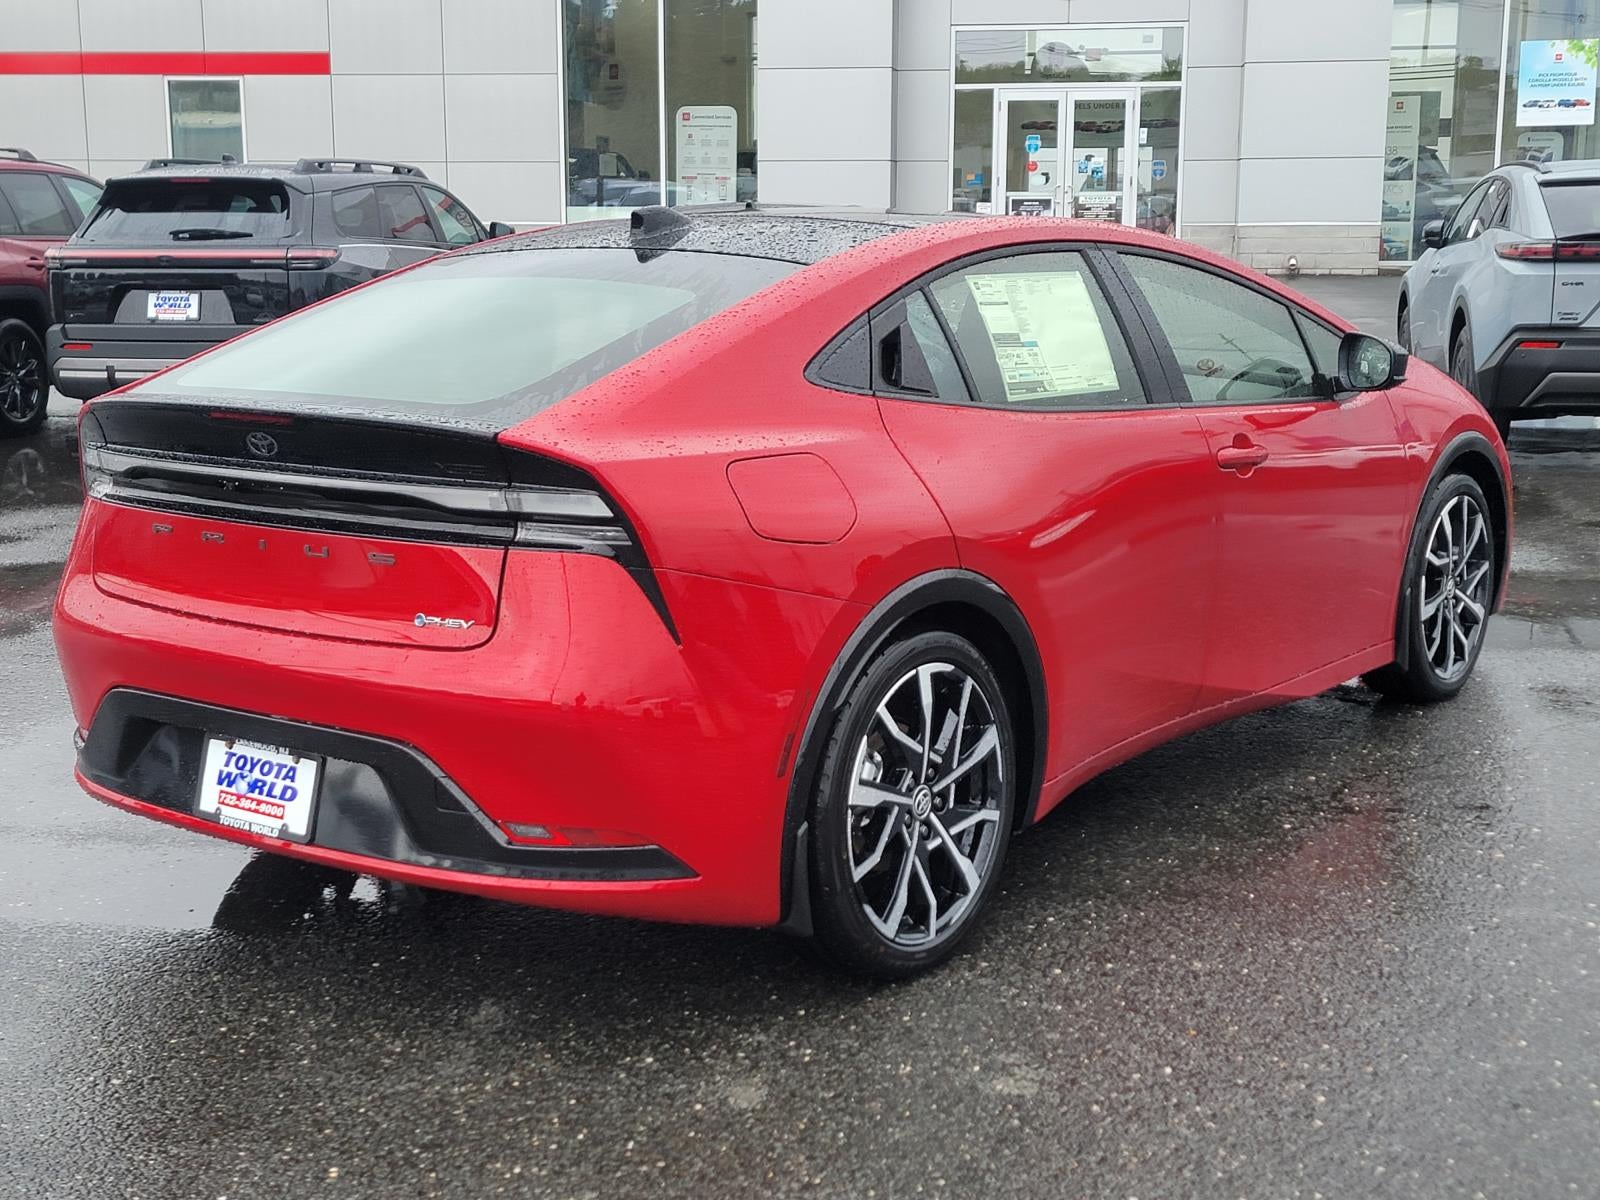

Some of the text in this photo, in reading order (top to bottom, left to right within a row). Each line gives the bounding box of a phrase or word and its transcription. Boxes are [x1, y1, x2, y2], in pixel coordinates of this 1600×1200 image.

[1093, 101, 1121, 110] UNDER
[152, 523, 396, 566] PRIUS
[425, 616, 475, 629] PHEV
[224, 751, 298, 783] TOYOTA
[216, 769, 299, 802] WORLD
[219, 815, 280, 838] TOYOTA WORLD
